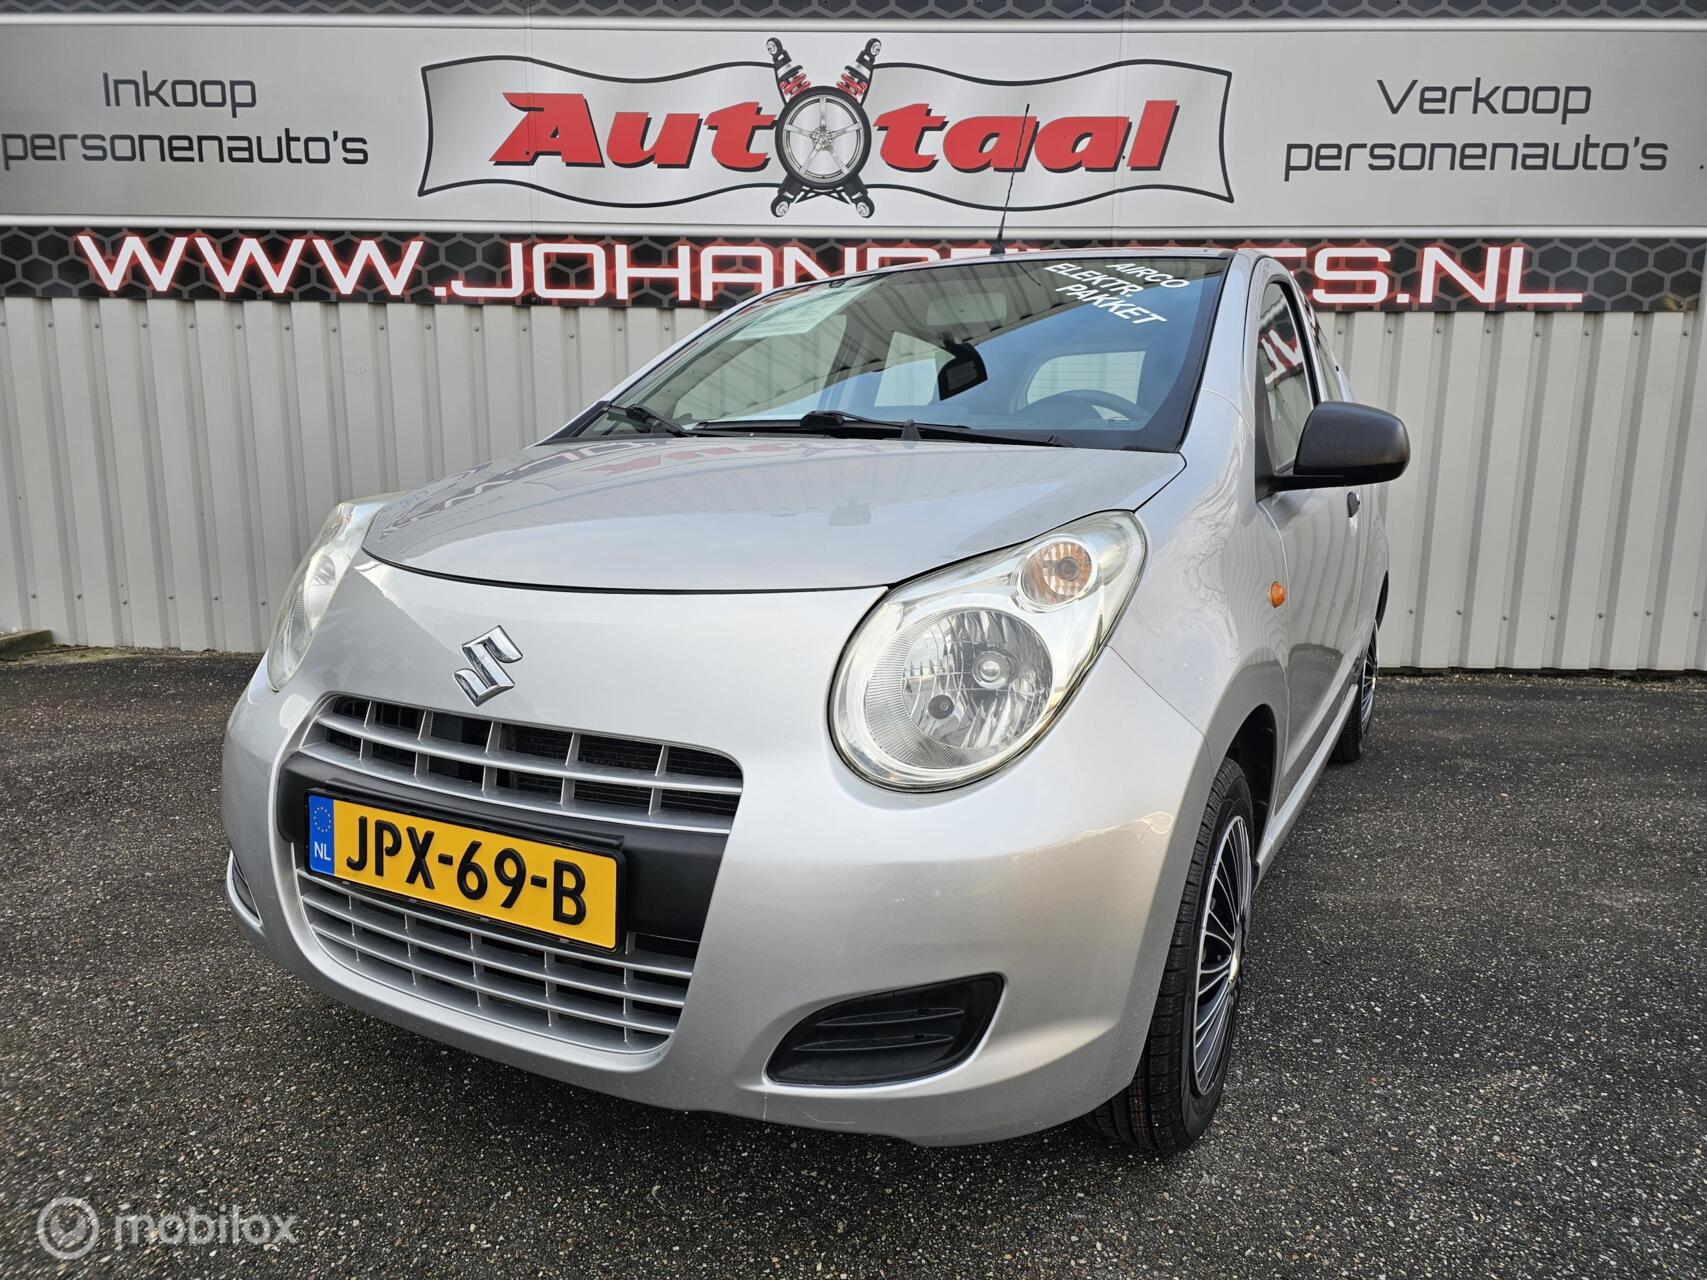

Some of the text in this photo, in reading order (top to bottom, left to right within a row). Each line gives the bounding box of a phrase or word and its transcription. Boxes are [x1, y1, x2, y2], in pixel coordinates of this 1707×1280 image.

[103, 70, 257, 118] Inkoop
[1378, 77, 1592, 126] Verkoop
[2, 128, 369, 171] personenauto's
[1285, 134, 1669, 182] personenauto's
[1044, 262, 1144, 297] ELEKTR.
[1105, 262, 1190, 289] AIRCO
[1055, 283, 1168, 324] PAKKET
[314, 841, 332, 862] NL
[346, 815, 586, 926] JPX-69-B
